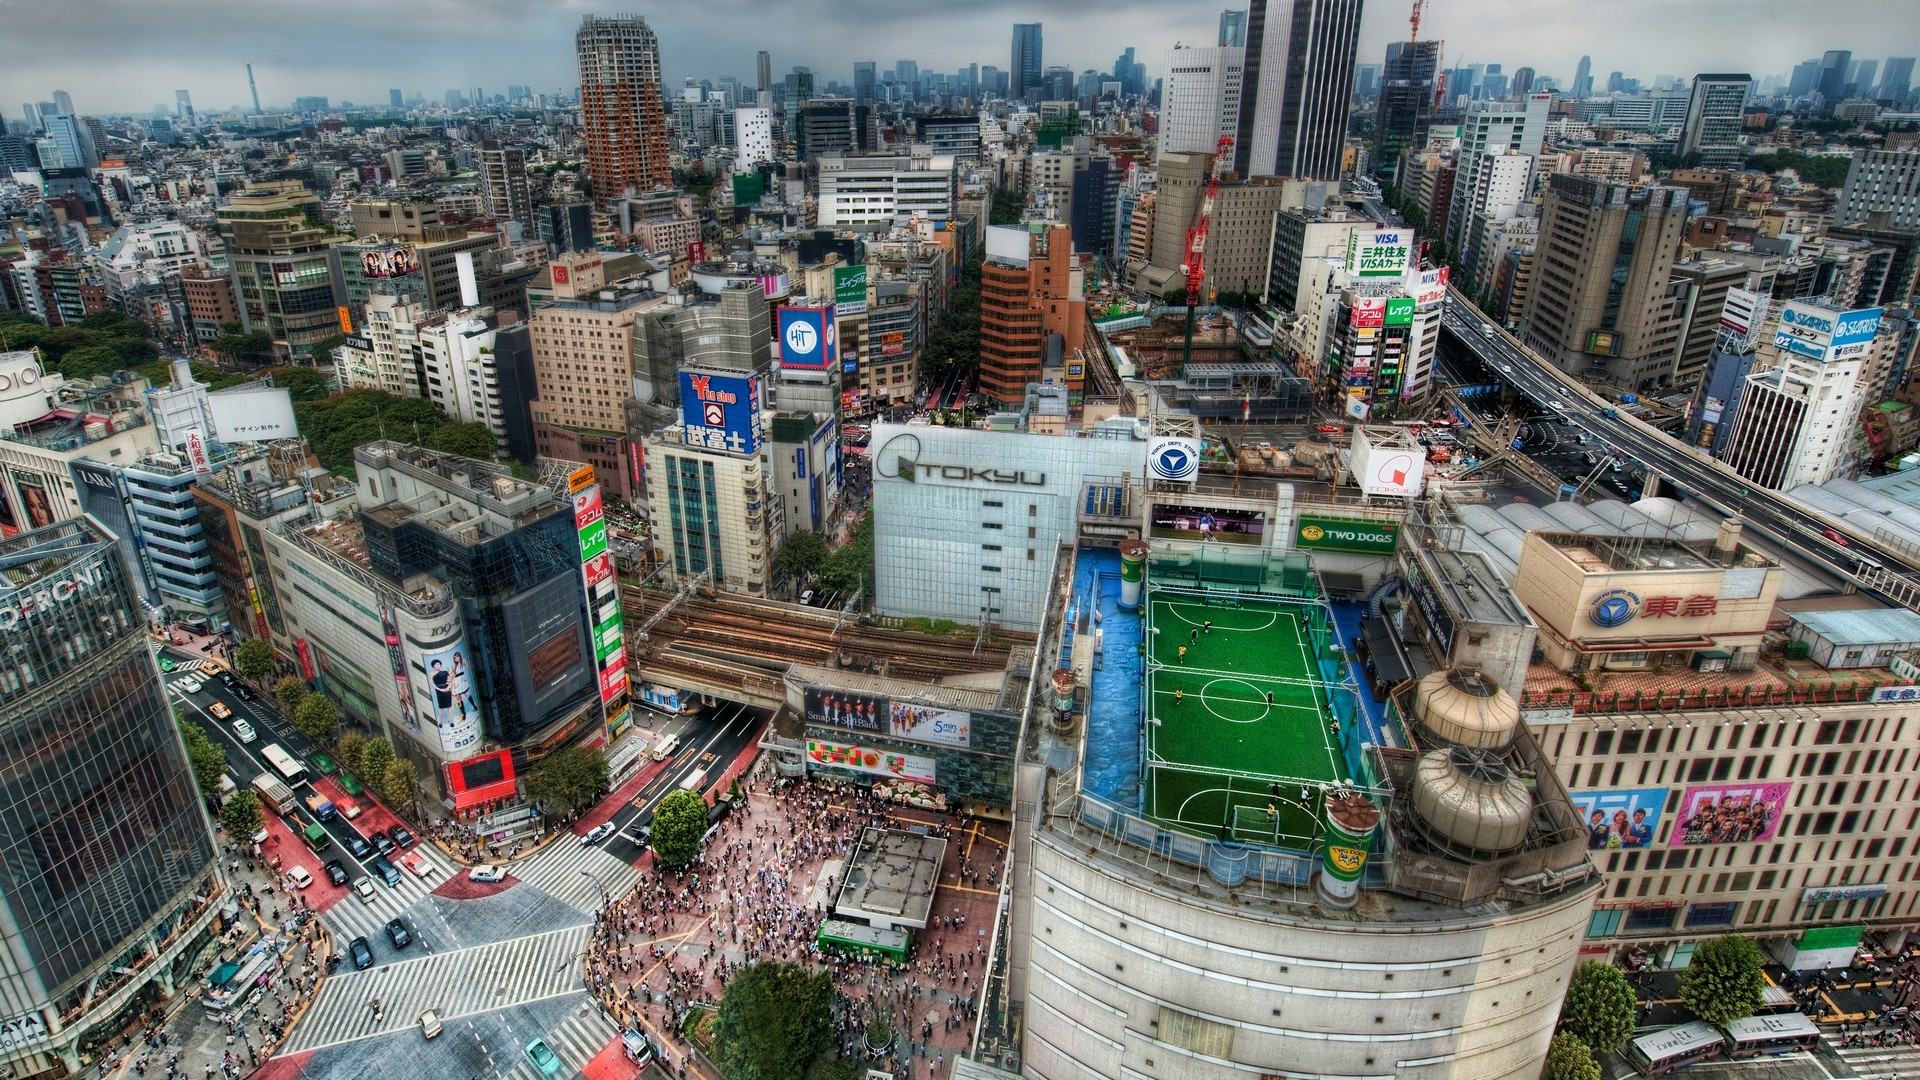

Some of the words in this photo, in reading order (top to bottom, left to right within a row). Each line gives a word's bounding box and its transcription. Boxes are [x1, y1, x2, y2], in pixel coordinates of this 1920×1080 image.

[1375, 234, 1398, 244] VISA
[1361, 246, 1407, 258] 三井住友
[1360, 258, 1406, 269] VISAカード
[1360, 311, 1382, 319] アコム
[1389, 306, 1412, 315] レイク
[1790, 327, 1817, 340] スターツ
[1846, 318, 1878, 336] STARTS
[687, 424, 746, 453] 武富士
[77, 469, 115, 489] ZARA
[916, 463, 1045, 486] TOKYU
[580, 508, 603, 526] アコム
[582, 529, 604, 551] レイク
[1325, 530, 1355, 540] TWO
[1357, 533, 1393, 543] DOGS
[587, 568, 610, 586] アイフル
[1641, 595, 1718, 619] 東急
[808, 711, 831, 724] Smap
[841, 716, 879, 730] SoftBank
